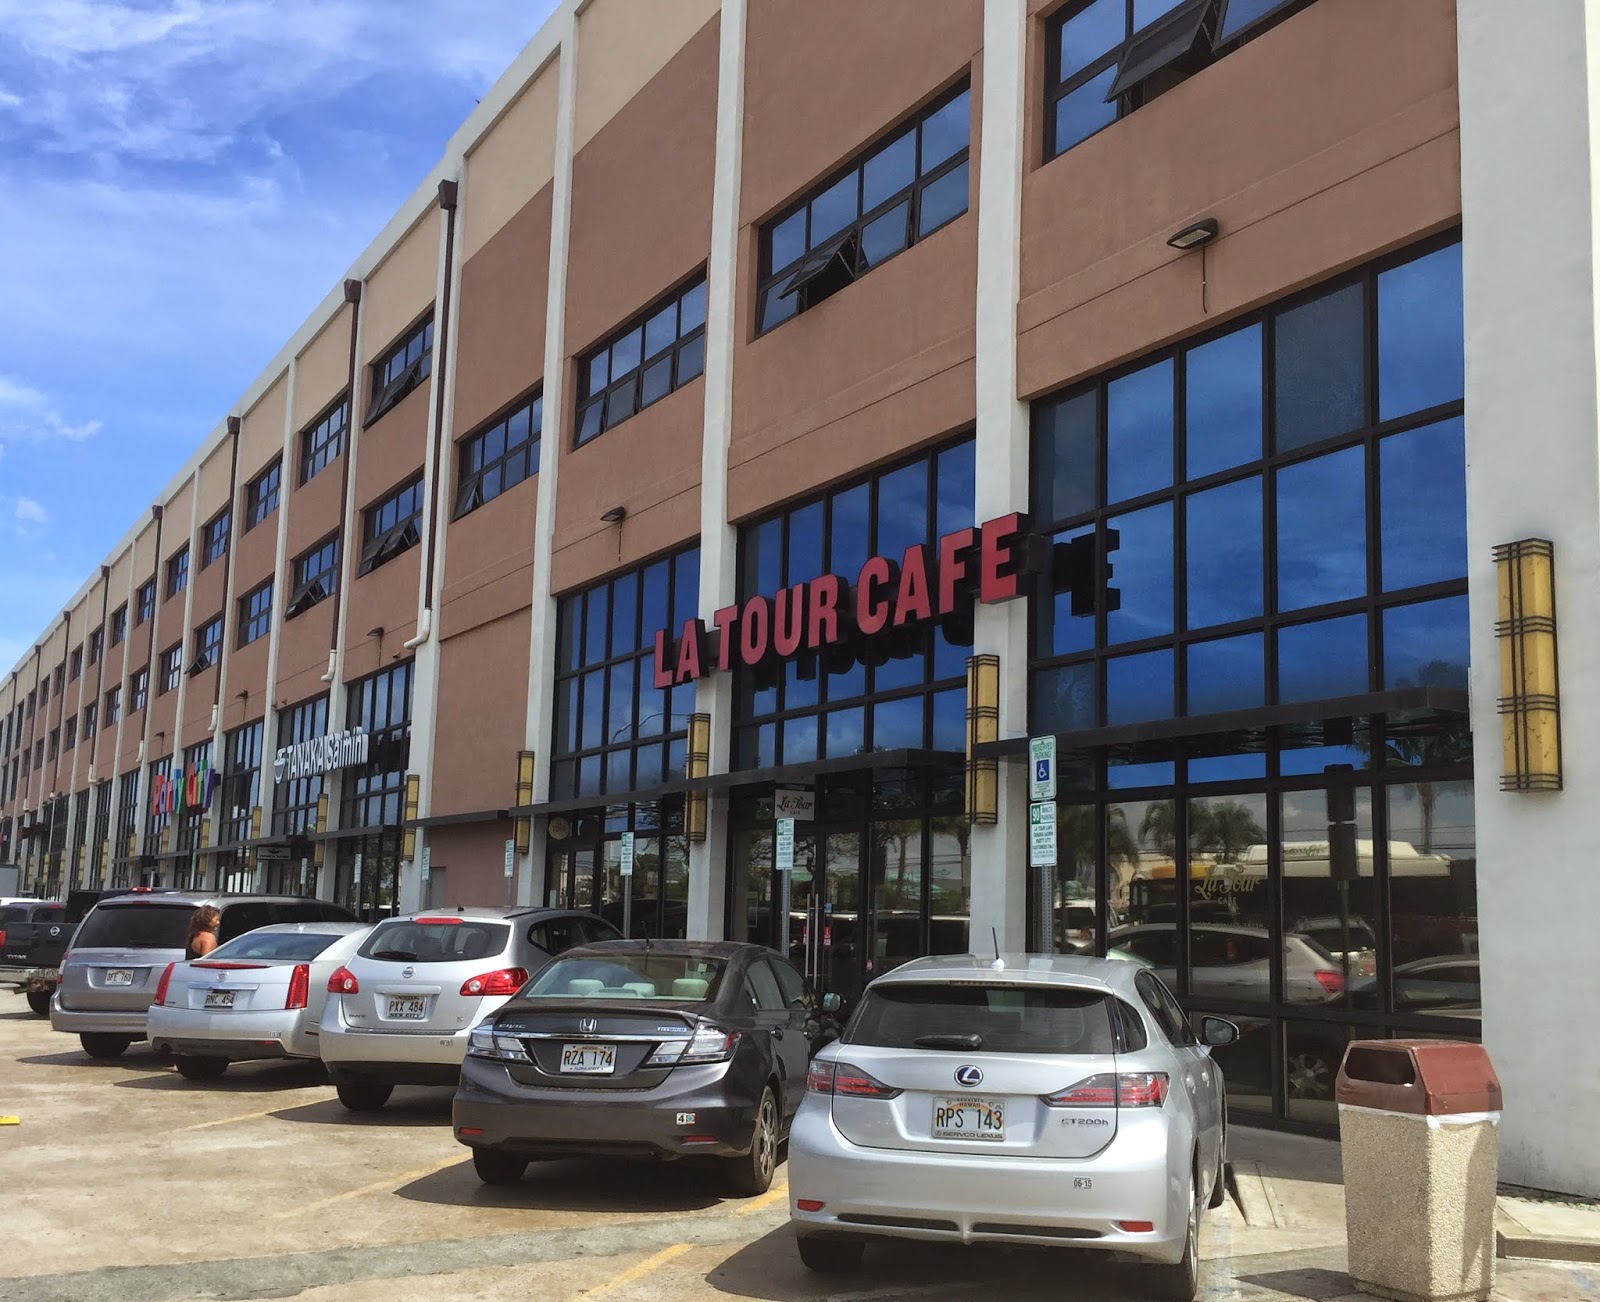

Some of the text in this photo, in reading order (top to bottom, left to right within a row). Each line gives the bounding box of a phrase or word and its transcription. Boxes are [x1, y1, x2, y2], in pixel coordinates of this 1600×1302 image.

[653, 512, 1024, 690] LA TOUR CAFE
[286, 727, 369, 781] TANAKA Saimin
[152, 759, 216, 816] Party City
[389, 1000, 424, 1013] PXX 484
[563, 1050, 613, 1066] RZA 174
[936, 1107, 1003, 1131] RPS 143
